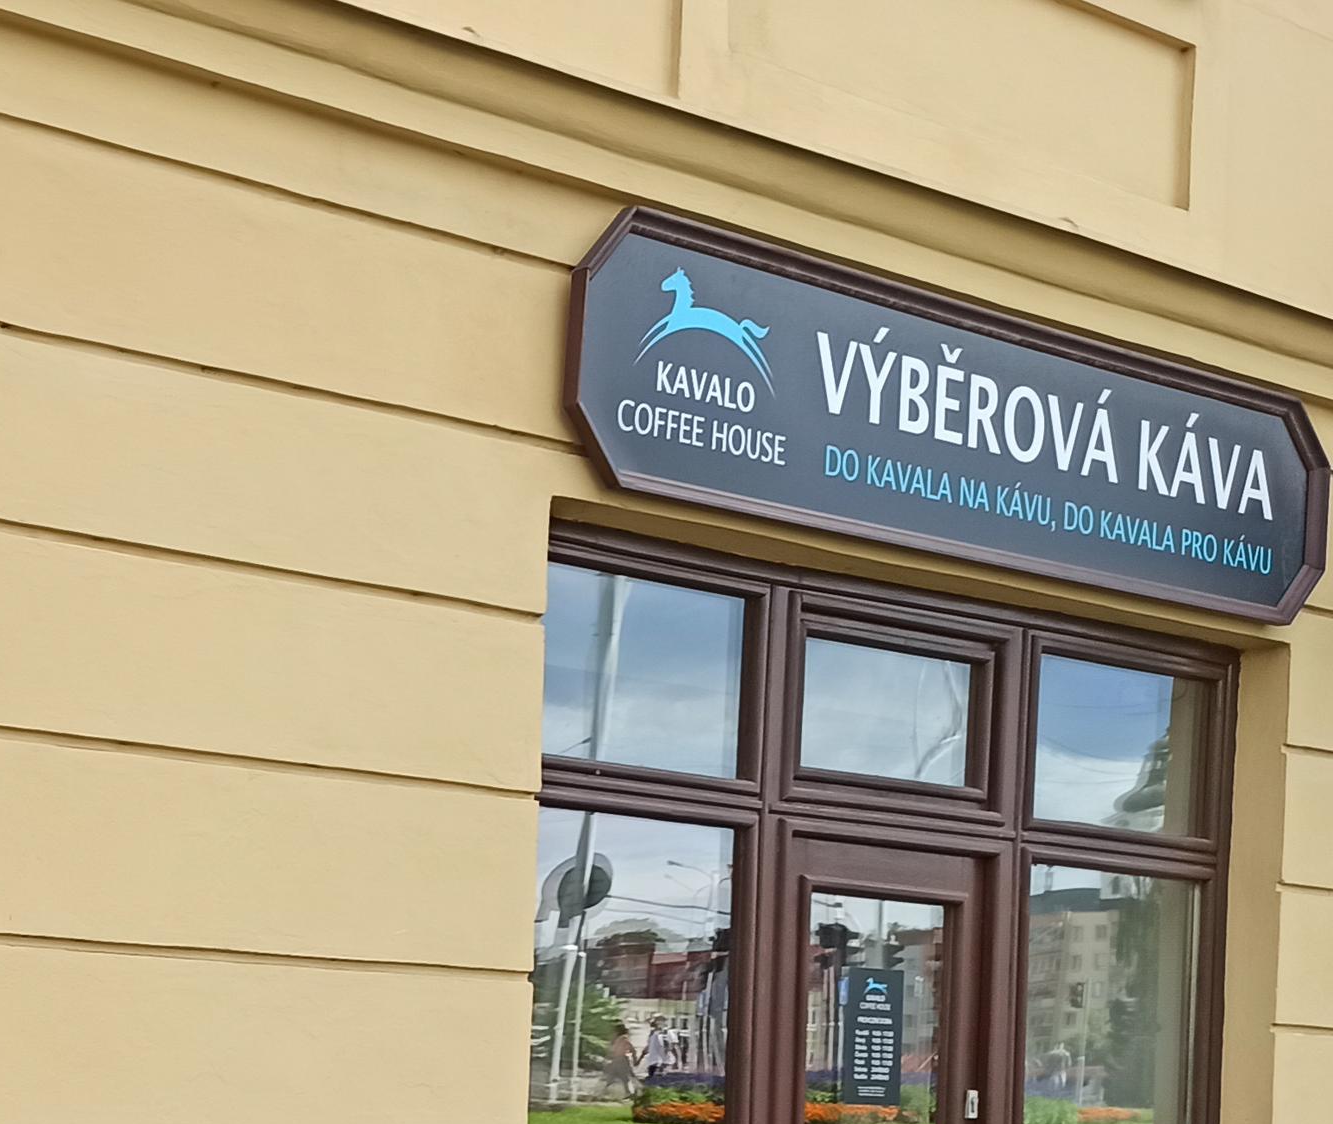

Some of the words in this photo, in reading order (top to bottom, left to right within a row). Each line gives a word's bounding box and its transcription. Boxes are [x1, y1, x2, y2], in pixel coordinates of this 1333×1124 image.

[617, 399, 706, 447] COFFEE
[711, 420, 787, 466] HOUSE
[656, 360, 756, 413] KAVALO
[816, 326, 1118, 484] VÝBĚROVÁ
[1137, 412, 1273, 521] KÁVA
[824, 445, 860, 482] DO
[866, 454, 953, 504] KAVALA
[959, 476, 990, 512] NA
[996, 481, 1057, 532] KÁVU,
[1063, 501, 1095, 535] DO
[1100, 509, 1175, 553] KAVALA
[1181, 528, 1218, 563] PRO
[1222, 534, 1273, 575] KÁVU
